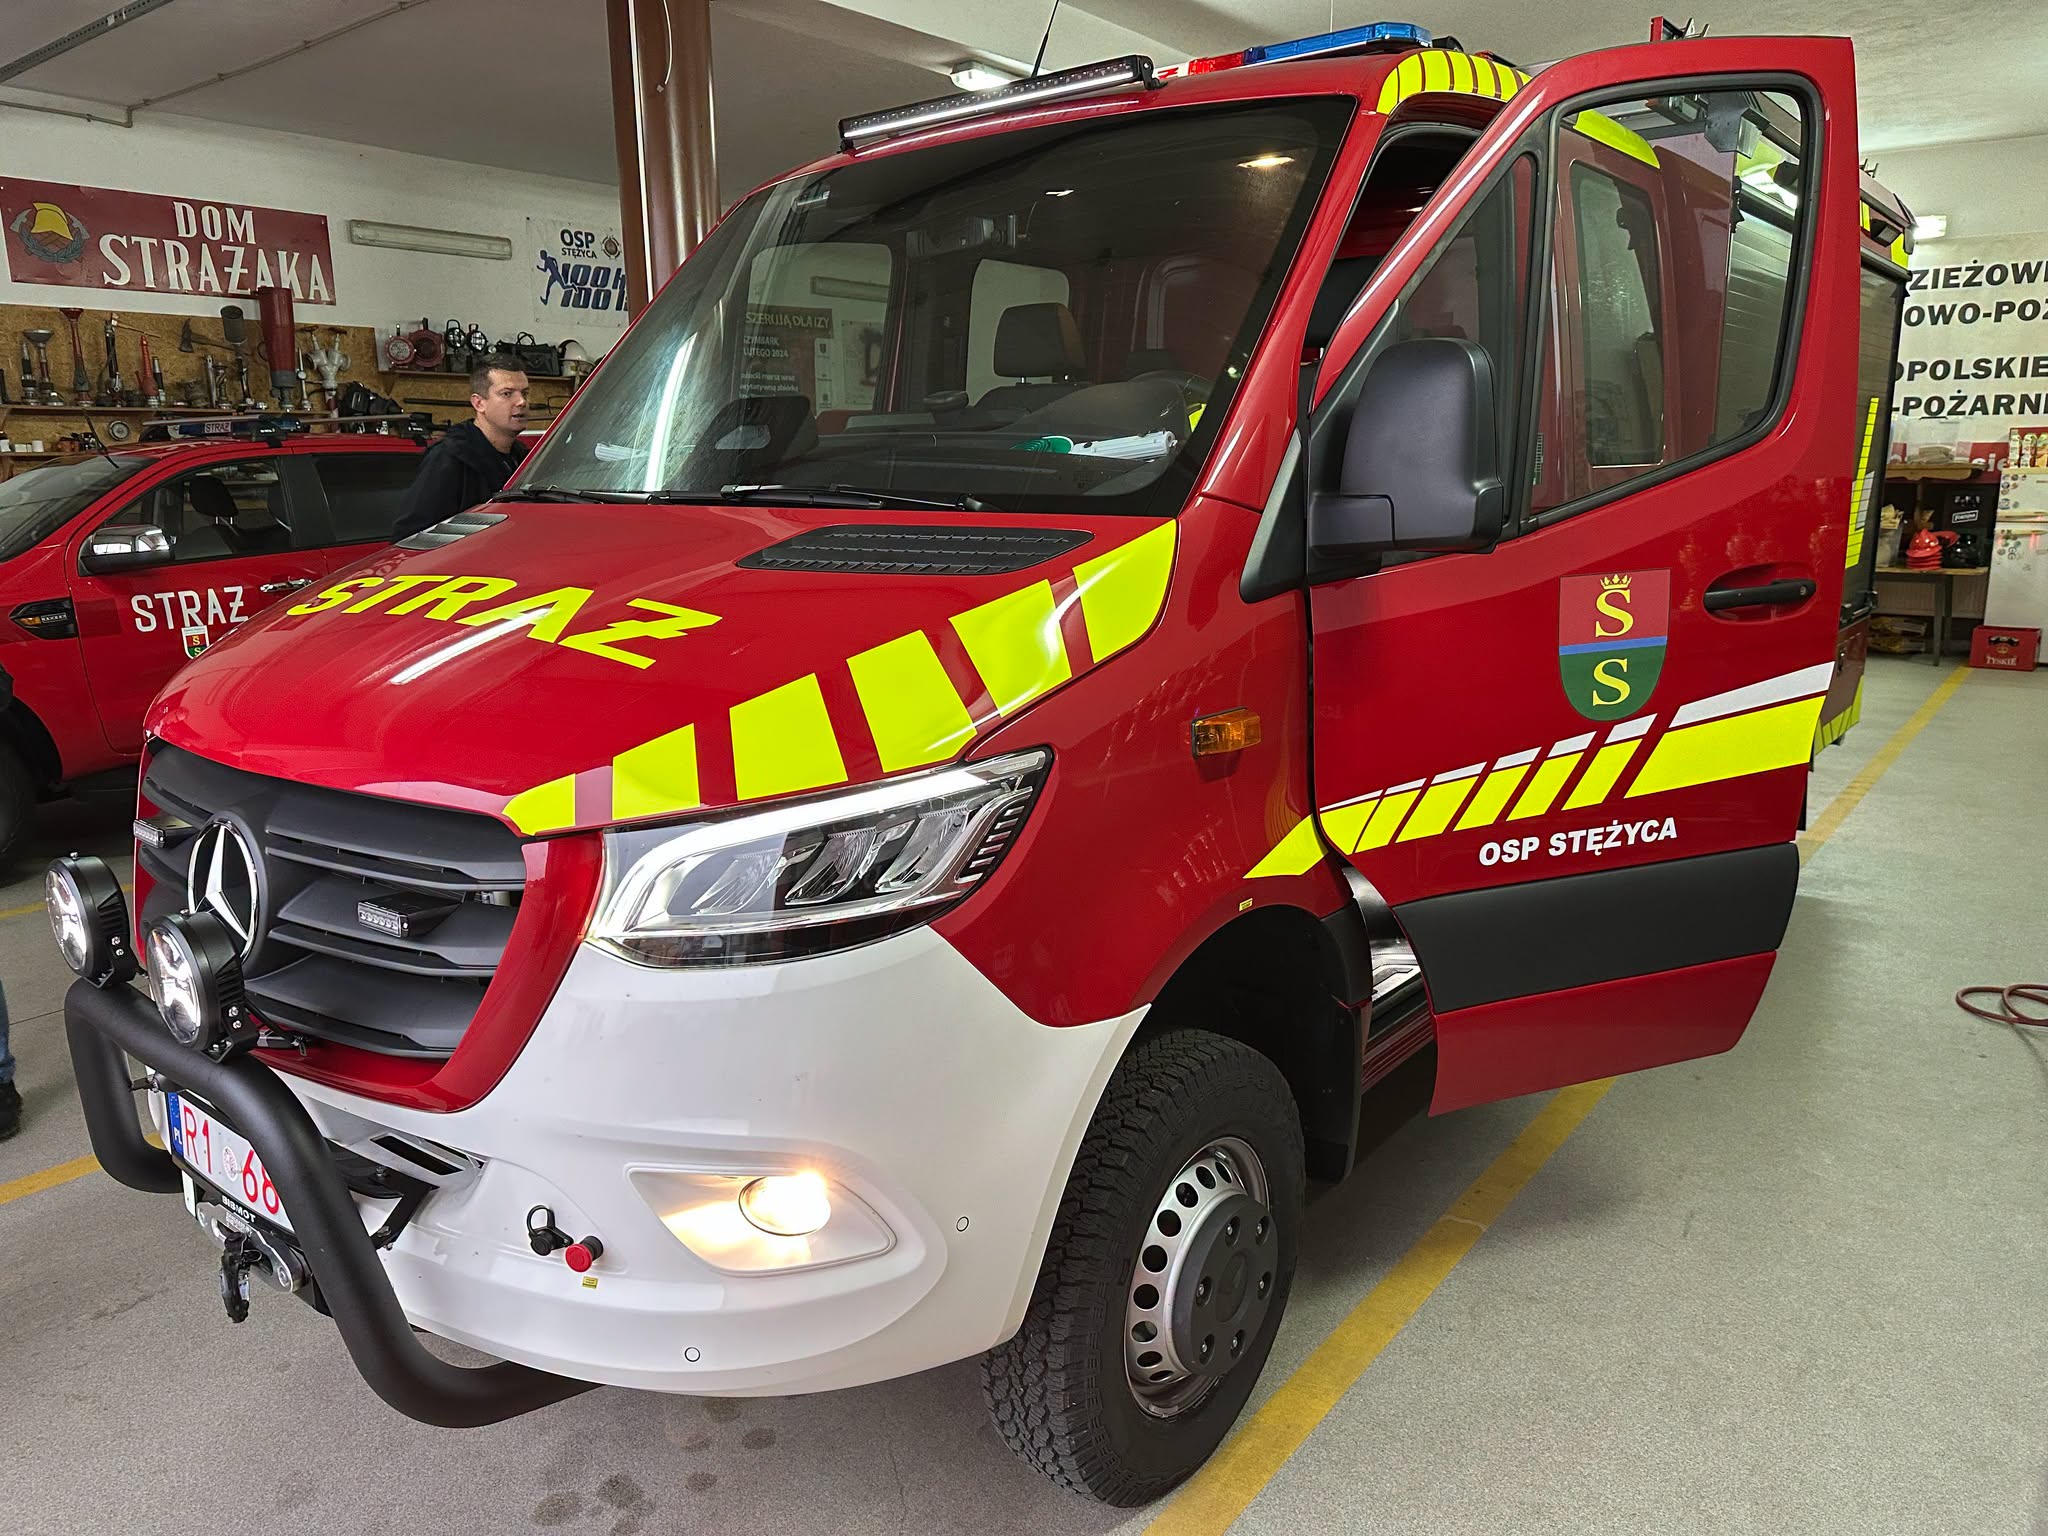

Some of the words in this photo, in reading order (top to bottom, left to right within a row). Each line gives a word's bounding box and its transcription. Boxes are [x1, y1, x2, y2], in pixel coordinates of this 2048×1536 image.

[173, 201, 256, 245] DOM
[560, 229, 595, 249] OSP
[1909, 260, 2048, 290] ZIEŻOW
[560, 287, 612, 311] 100
[792, 315, 813, 328] DLA
[1595, 589, 1634, 637] S
[1592, 658, 1631, 706] S
[1479, 836, 1540, 866] OSP
[1548, 817, 1678, 856] STĘŻYCA
[173, 1127, 183, 1145] PL
[183, 1105, 213, 1175] R1
